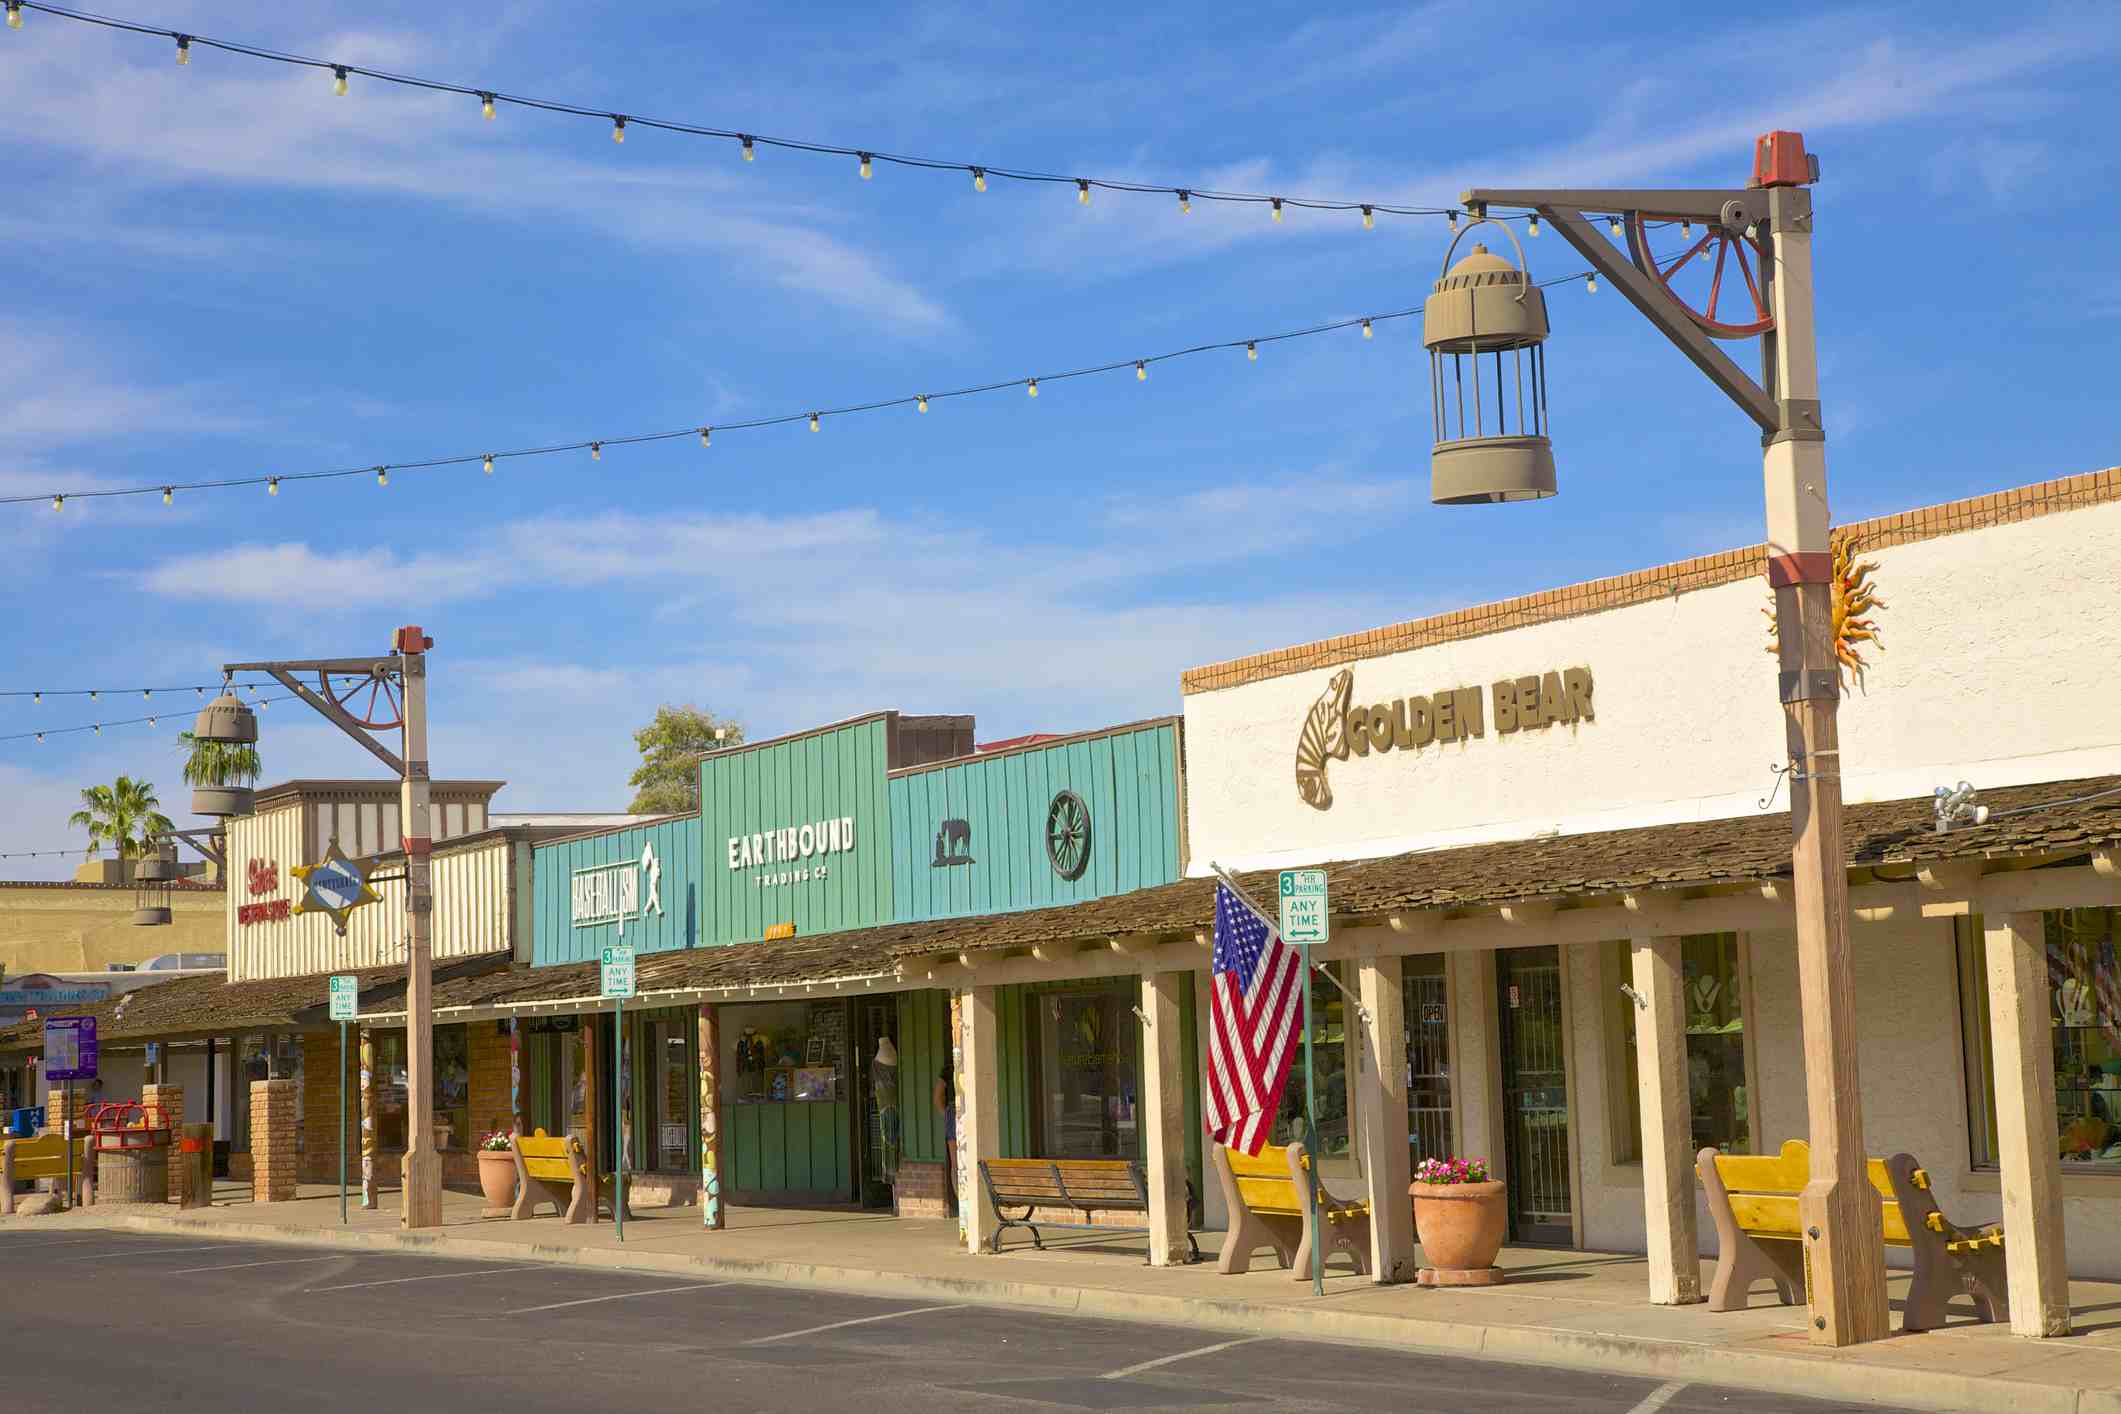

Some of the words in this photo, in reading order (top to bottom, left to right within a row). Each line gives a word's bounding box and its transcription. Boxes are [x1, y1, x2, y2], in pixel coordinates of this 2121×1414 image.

[1346, 685, 1484, 757] GOLDEN
[1492, 667, 1594, 734] BEAR
[728, 816, 855, 870] EARTHBOUND
[755, 869, 809, 887] TRADING
[1282, 876, 1293, 894] 3
[1290, 900, 1316, 911] ANY
[1289, 914, 1319, 926] TIME
[603, 950, 611, 963] 3
[608, 967, 628, 976] ANY
[332, 978, 338, 990] 3
[608, 977, 628, 986] TIME
[335, 993, 351, 1001] ANY
[335, 1002, 352, 1010] TIME
[1424, 1004, 1444, 1021] OPEN
